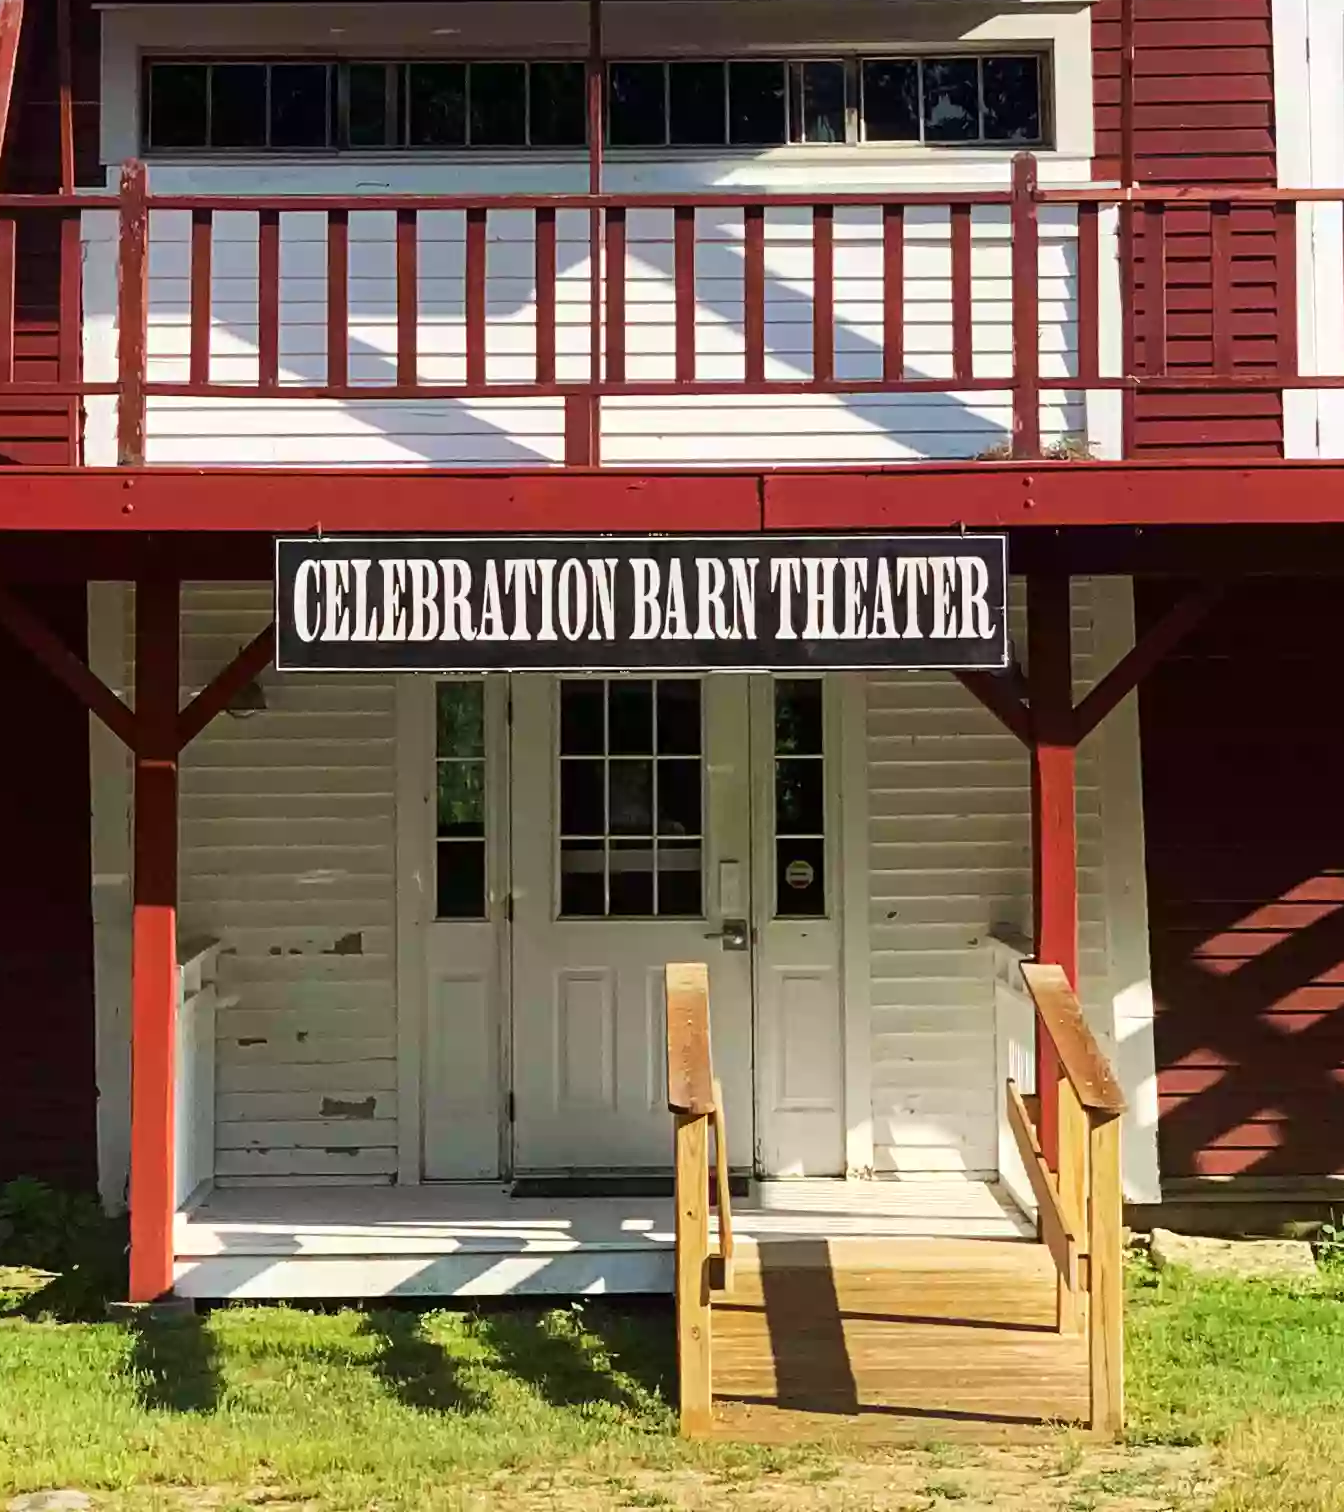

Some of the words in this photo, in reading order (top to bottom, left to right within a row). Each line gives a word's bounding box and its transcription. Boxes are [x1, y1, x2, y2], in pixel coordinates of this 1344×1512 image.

[293, 558, 619, 642] CELEBRATION
[629, 557, 760, 640] BARN
[770, 556, 997, 640] THEATER
